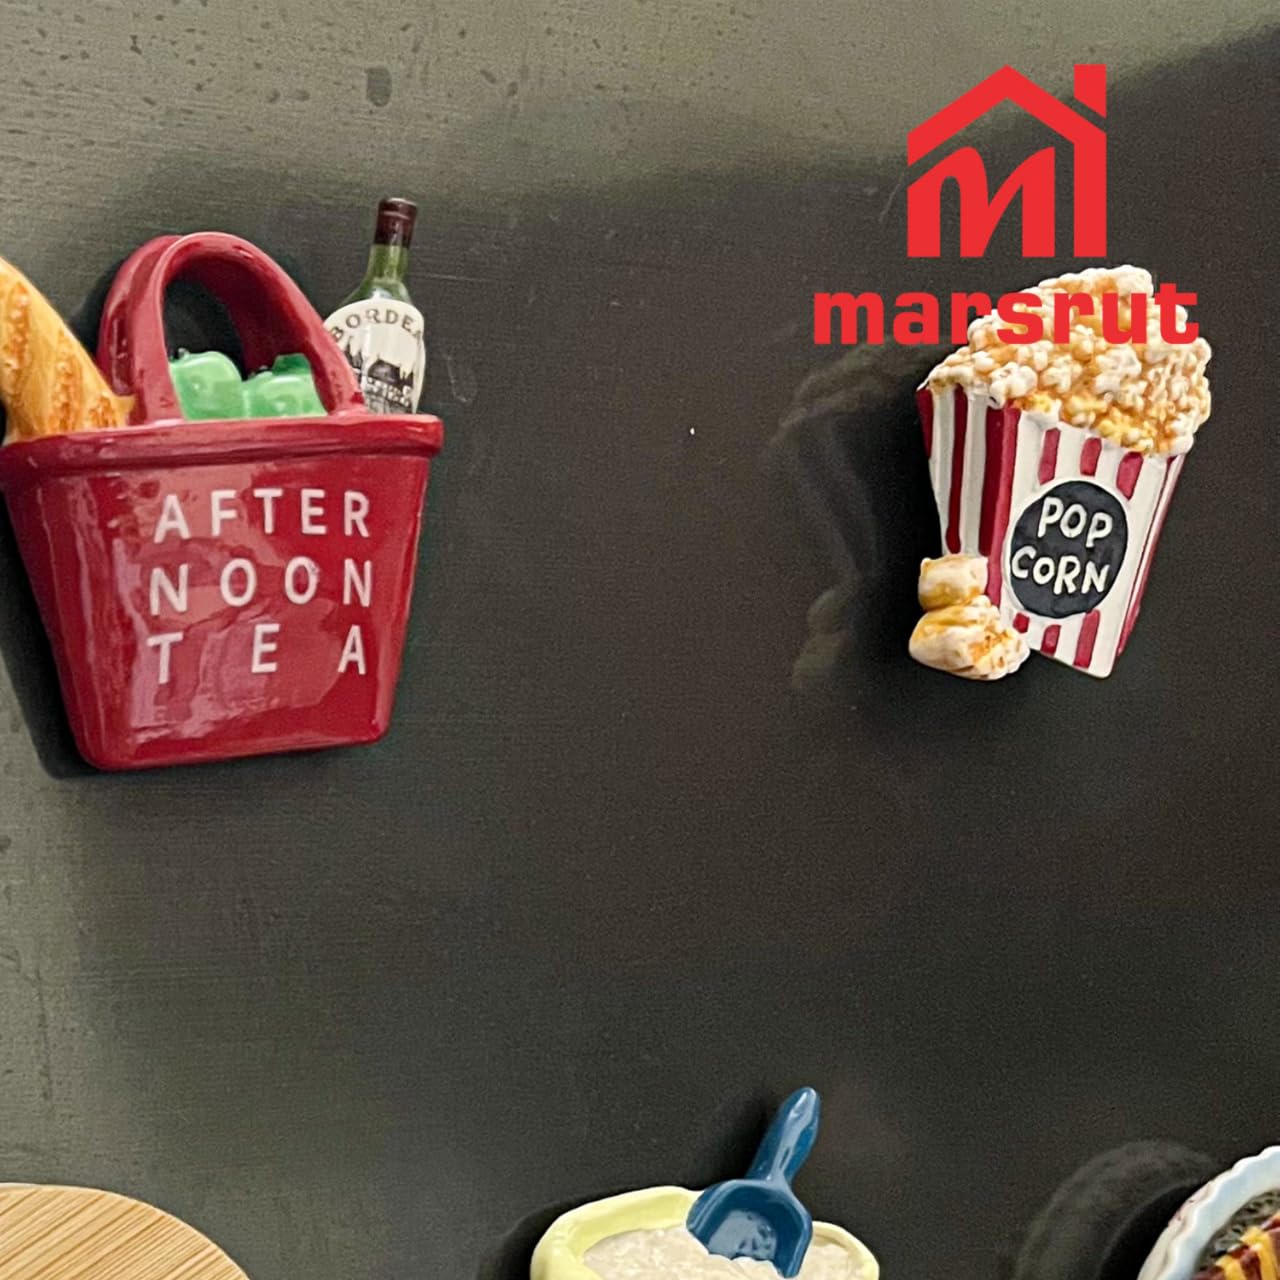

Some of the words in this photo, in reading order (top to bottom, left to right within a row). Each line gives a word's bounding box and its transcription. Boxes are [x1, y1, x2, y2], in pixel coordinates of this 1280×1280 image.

[154, 489, 370, 544] AFTER
[1037, 496, 1113, 548] POP
[149, 556, 372, 616] NOON
[1012, 545, 1110, 595] CORN
[147, 623, 367, 684] TEA
